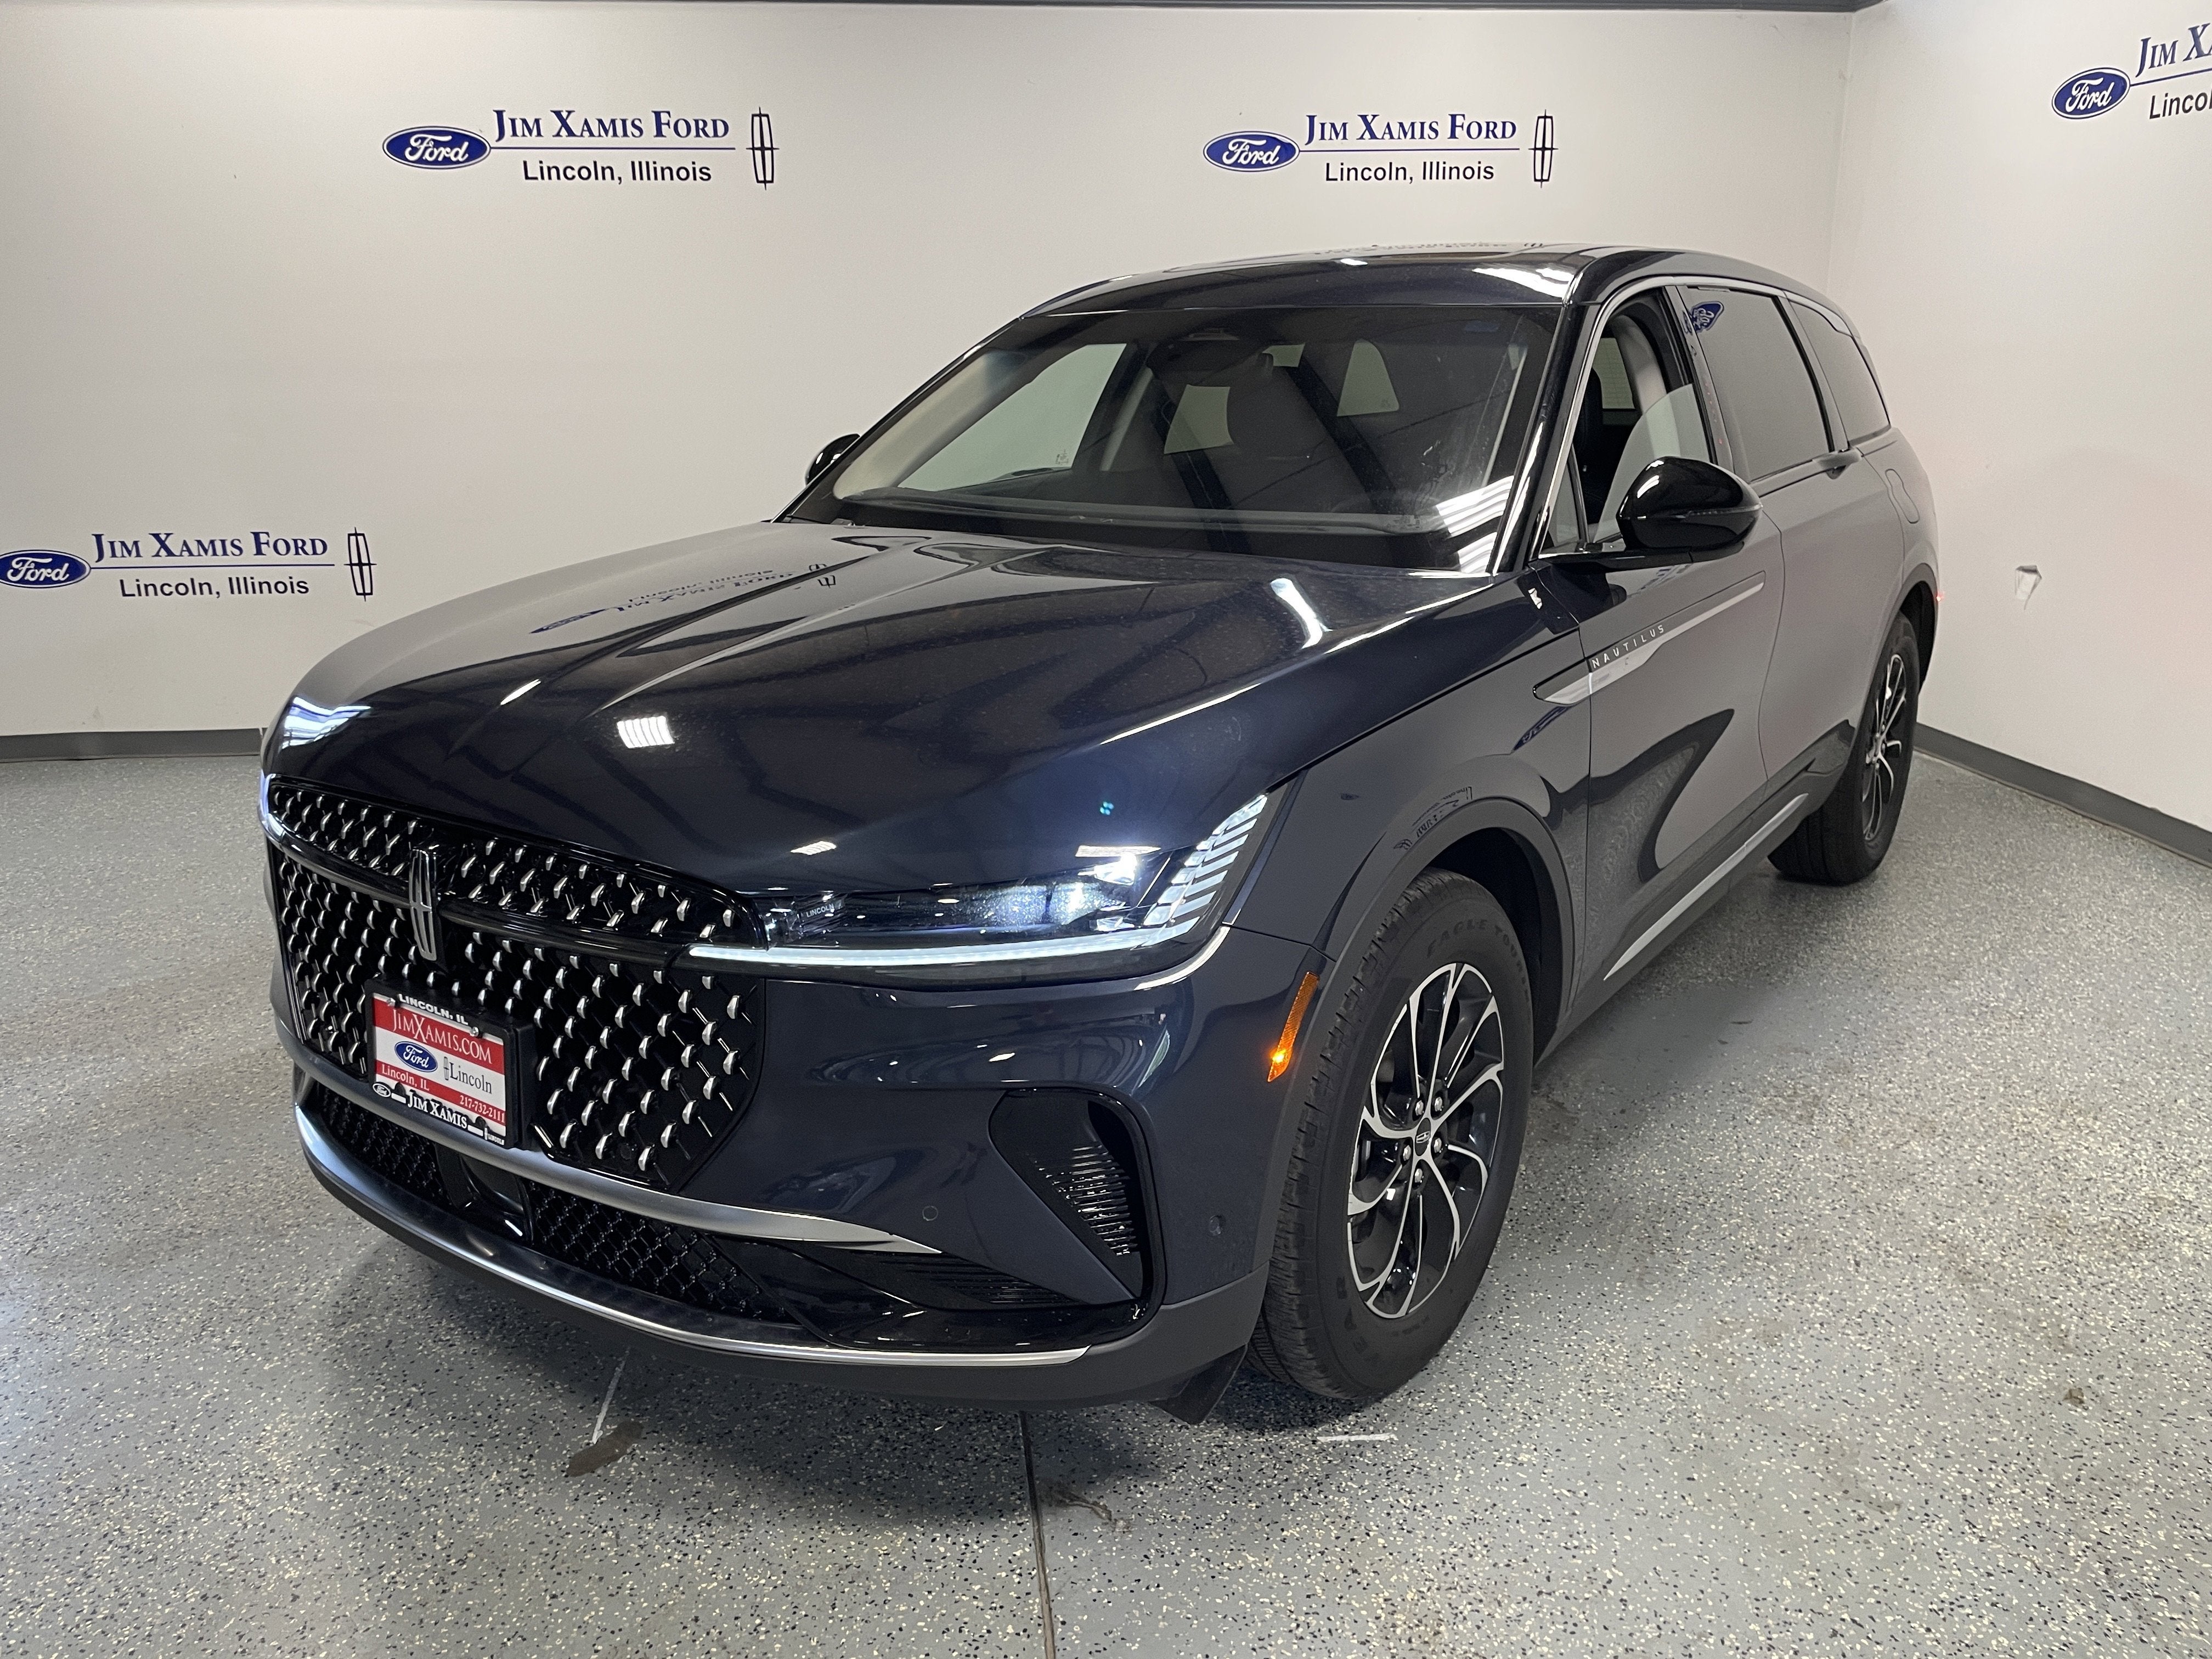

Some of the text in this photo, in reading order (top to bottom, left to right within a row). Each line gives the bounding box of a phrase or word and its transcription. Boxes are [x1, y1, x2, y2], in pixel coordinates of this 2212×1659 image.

[2066, 77, 2115, 112] Ford
[404, 133, 469, 163] Ford
[1221, 138, 1280, 166] Ford
[523, 160, 712, 185] Lincoln, Illinois
[1325, 161, 1494, 184] Lincoln, Illinois
[6, 557, 70, 583] Ford
[119, 576, 309, 599] Lincoln, Illinois
[1592, 624, 1664, 669] NAUTILUS
[806, 903, 834, 918] LINCOLN
[398, 994, 469, 1025] LINCOLN, IL
[403, 1045, 429, 1069] Ford
[381, 1063, 430, 1091] Lincoln, IL
[449, 1062, 493, 1094] Lincoln
[408, 1091, 468, 1129] JIM XAMIS
[459, 1094, 506, 1124] 217-732-2111
